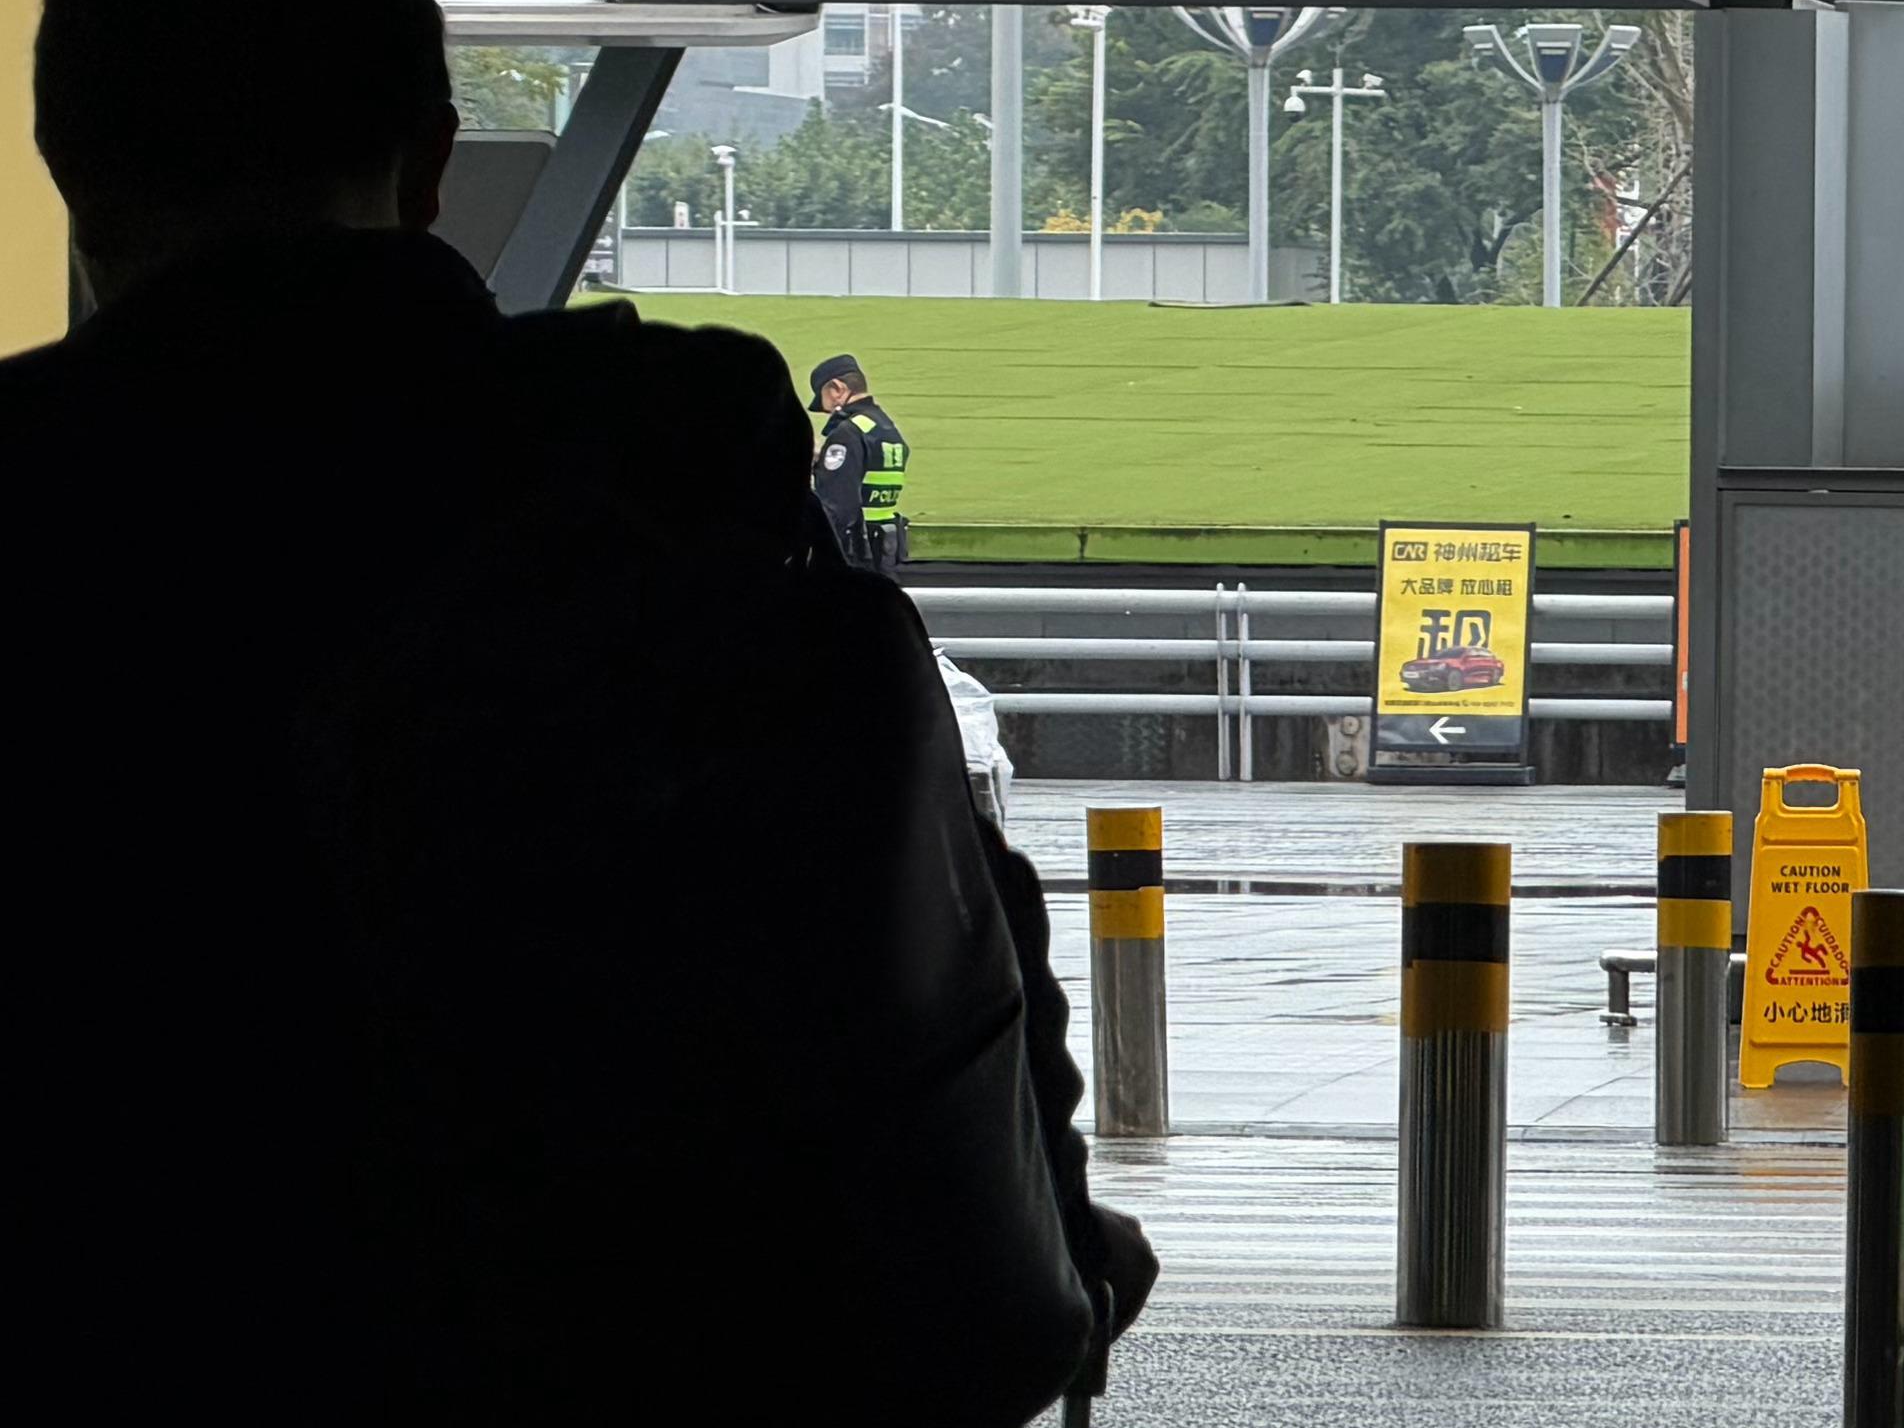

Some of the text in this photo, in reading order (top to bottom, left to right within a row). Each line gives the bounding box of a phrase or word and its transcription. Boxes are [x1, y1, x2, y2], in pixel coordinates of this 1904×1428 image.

[1434, 542, 1522, 562] 神州租车
[1780, 864, 1841, 877] CAUTION
[1771, 881, 1850, 893] WET FLOOR
[1770, 915, 1805, 968] CAUTION
[1815, 917, 1849, 970] CUIDADO
[1780, 976, 1839, 986] ATTENTION
